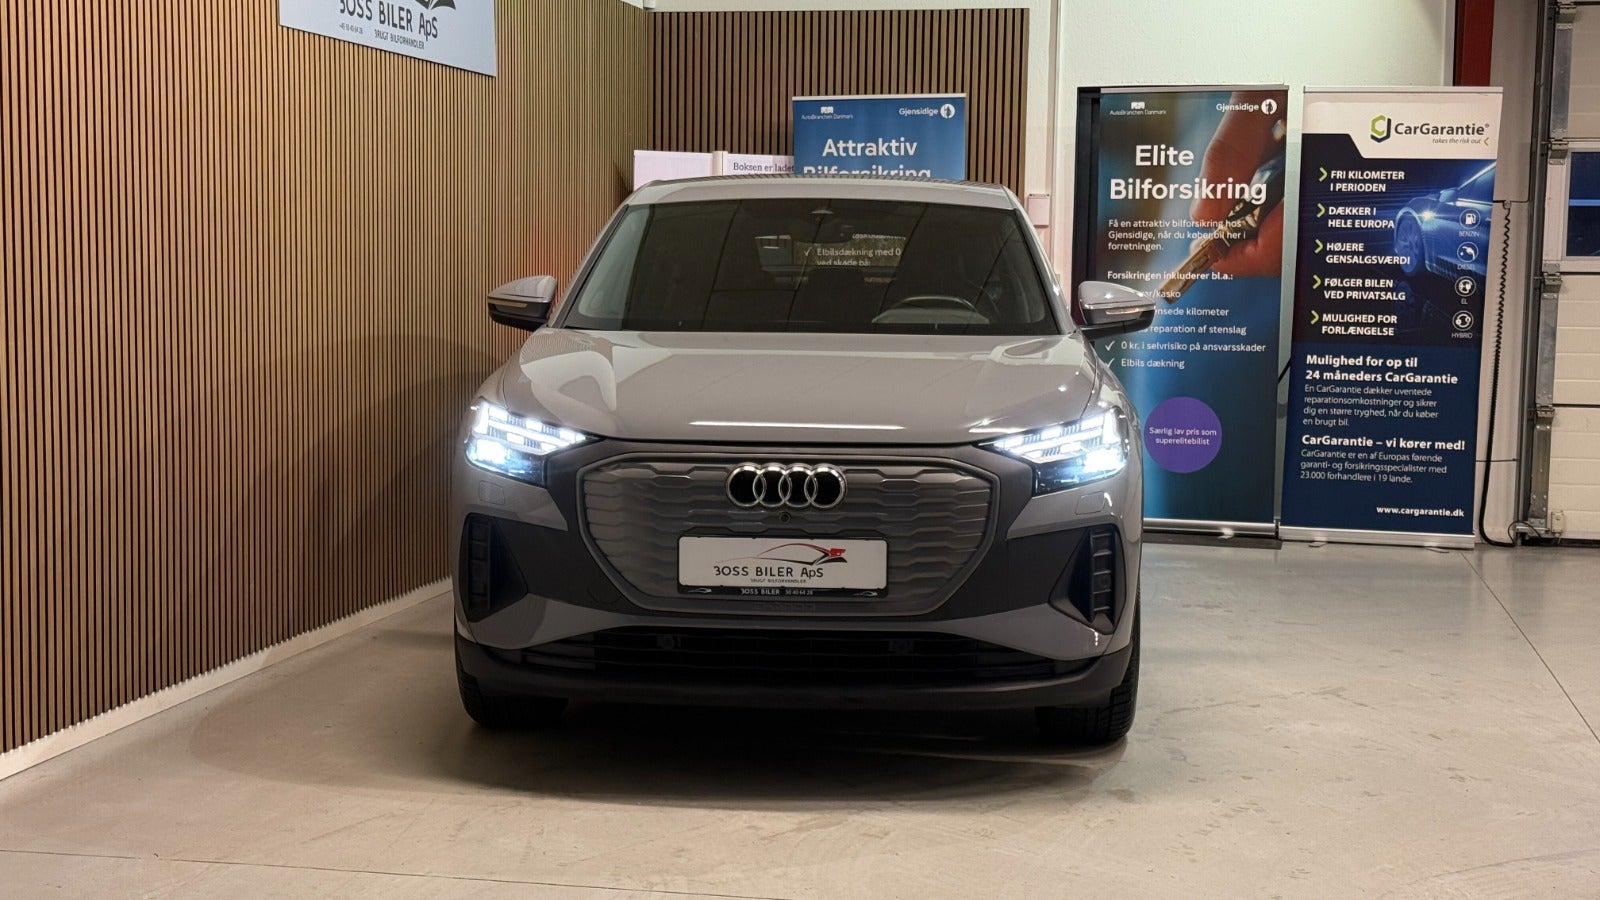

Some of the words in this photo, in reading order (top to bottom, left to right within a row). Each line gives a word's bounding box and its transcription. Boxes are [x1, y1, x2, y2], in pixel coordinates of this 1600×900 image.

[379, 1, 413, 32] BILER
[419, 12, 438, 41] ApS
[898, 107, 938, 117] Gjensidige
[1216, 103, 1259, 112] Gjensidige
[822, 137, 917, 157] Attraktiv
[1135, 144, 1194, 166] Elite
[733, 162, 763, 171] Boksen
[774, 163, 794, 172] ladet
[1330, 171, 1345, 179] FRI
[1348, 171, 1405, 180] KILOMETER
[1110, 177, 1267, 205] Bilforsikring
[1330, 183, 1333, 191] I
[1336, 183, 1386, 192] PERIODEN
[1329, 207, 1371, 215] DÆKKER
[1373, 207, 1376, 215] I
[1108, 219, 1119, 228] Få
[1133, 219, 1170, 228] attraktiv
[1172, 219, 1223, 229] bilforsikring
[1225, 219, 1242, 228] hos
[1328, 219, 1353, 228] HELE
[1355, 220, 1395, 228] EUROPA
[1108, 231, 1155, 240] Gjensidige,
[1158, 230, 1172, 239] når
[1174, 231, 1185, 239] du
[1187, 231, 1213, 239] køber
[1213, 231, 1224, 239] bil
[1226, 231, 1241, 239] her
[1243, 231, 1246, 239] i
[1108, 242, 1164, 252] forretningen.
[1327, 242, 1364, 251] HØJERE
[816, 248, 874, 257] Elbilsdækning
[875, 248, 894, 256] med
[1326, 255, 1410, 264] GENSALGSVÆRDI
[1107, 270, 1162, 281] Forsikringen
[1164, 271, 1210, 280] inkluderer
[1211, 271, 1233, 280] bl.a.:
[1324, 278, 1363, 287] FØLGER
[1365, 279, 1393, 287] BILEN
[1324, 291, 1344, 299] VED
[1346, 291, 1406, 300] PRIVATSALG
[1186, 307, 1229, 316] kilometer
[1322, 314, 1375, 323] MULIGHED
[1378, 315, 1397, 324] FOR
[1150, 325, 1196, 335] reparation
[1198, 325, 1207, 333] af
[1209, 326, 1246, 336] stenslag
[1322, 326, 1394, 335] FORLÆNGELSE
[1121, 341, 1126, 349] 0
[1128, 341, 1139, 350] kr.
[1146, 342, 1188, 350] selvrisiko
[1189, 343, 1200, 352] på
[1202, 344, 1266, 352] ansvarsskader
[1121, 358, 1144, 367] Elbils
[1146, 359, 1185, 369] dækning
[1306, 355, 1363, 368] Mulighed
[1366, 356, 1384, 367] for
[1386, 359, 1402, 369] op
[1405, 357, 1418, 367] til
[1305, 371, 1320, 380] 24
[1323, 370, 1382, 382] måneders
[1385, 372, 1458, 384] CarGarantie
[1305, 384, 1315, 392] En
[1316, 385, 1362, 394] CarGarantie
[1364, 386, 1393, 394] dækker
[1394, 388, 1432, 396] uventede
[1304, 396, 1401, 407] reparationsomkostninger
[1403, 399, 1414, 408] og
[1416, 399, 1437, 407] sikrer
[1304, 407, 1316, 416] dig
[1354, 408, 1386, 418] tryghed,
[1403, 409, 1413, 417] du
[1416, 410, 1438, 418] køber
[1315, 418, 1336, 427] brugt
[1338, 418, 1349, 426] bil.
[1149, 427, 1172, 436] Særlig
[1186, 428, 1199, 436] pris
[1156, 437, 1209, 445] superelitebilist
[1302, 435, 1373, 447] CarGarantie
[1386, 438, 1396, 447] vi
[1400, 438, 1432, 449] kører
[1435, 440, 1465, 450] med!
[1301, 449, 1346, 458] CarGarantie
[1370, 452, 1377, 460] af
[1379, 452, 1410, 461] Europas
[1412, 453, 1443, 462] førende
[1300, 461, 1331, 470] garanti-
[1332, 463, 1343, 471] og
[1344, 462, 1427, 473] forsikringsspecialister
[1429, 465, 1447, 473] med
[1327, 472, 1372, 481] forhandlere
[1378, 474, 1388, 482] 19
[1389, 475, 1412, 483] lande.
[1376, 506, 1464, 517] www.cargarantie.dk
[756, 566, 794, 577] BILER
[800, 567, 824, 579] ApS
